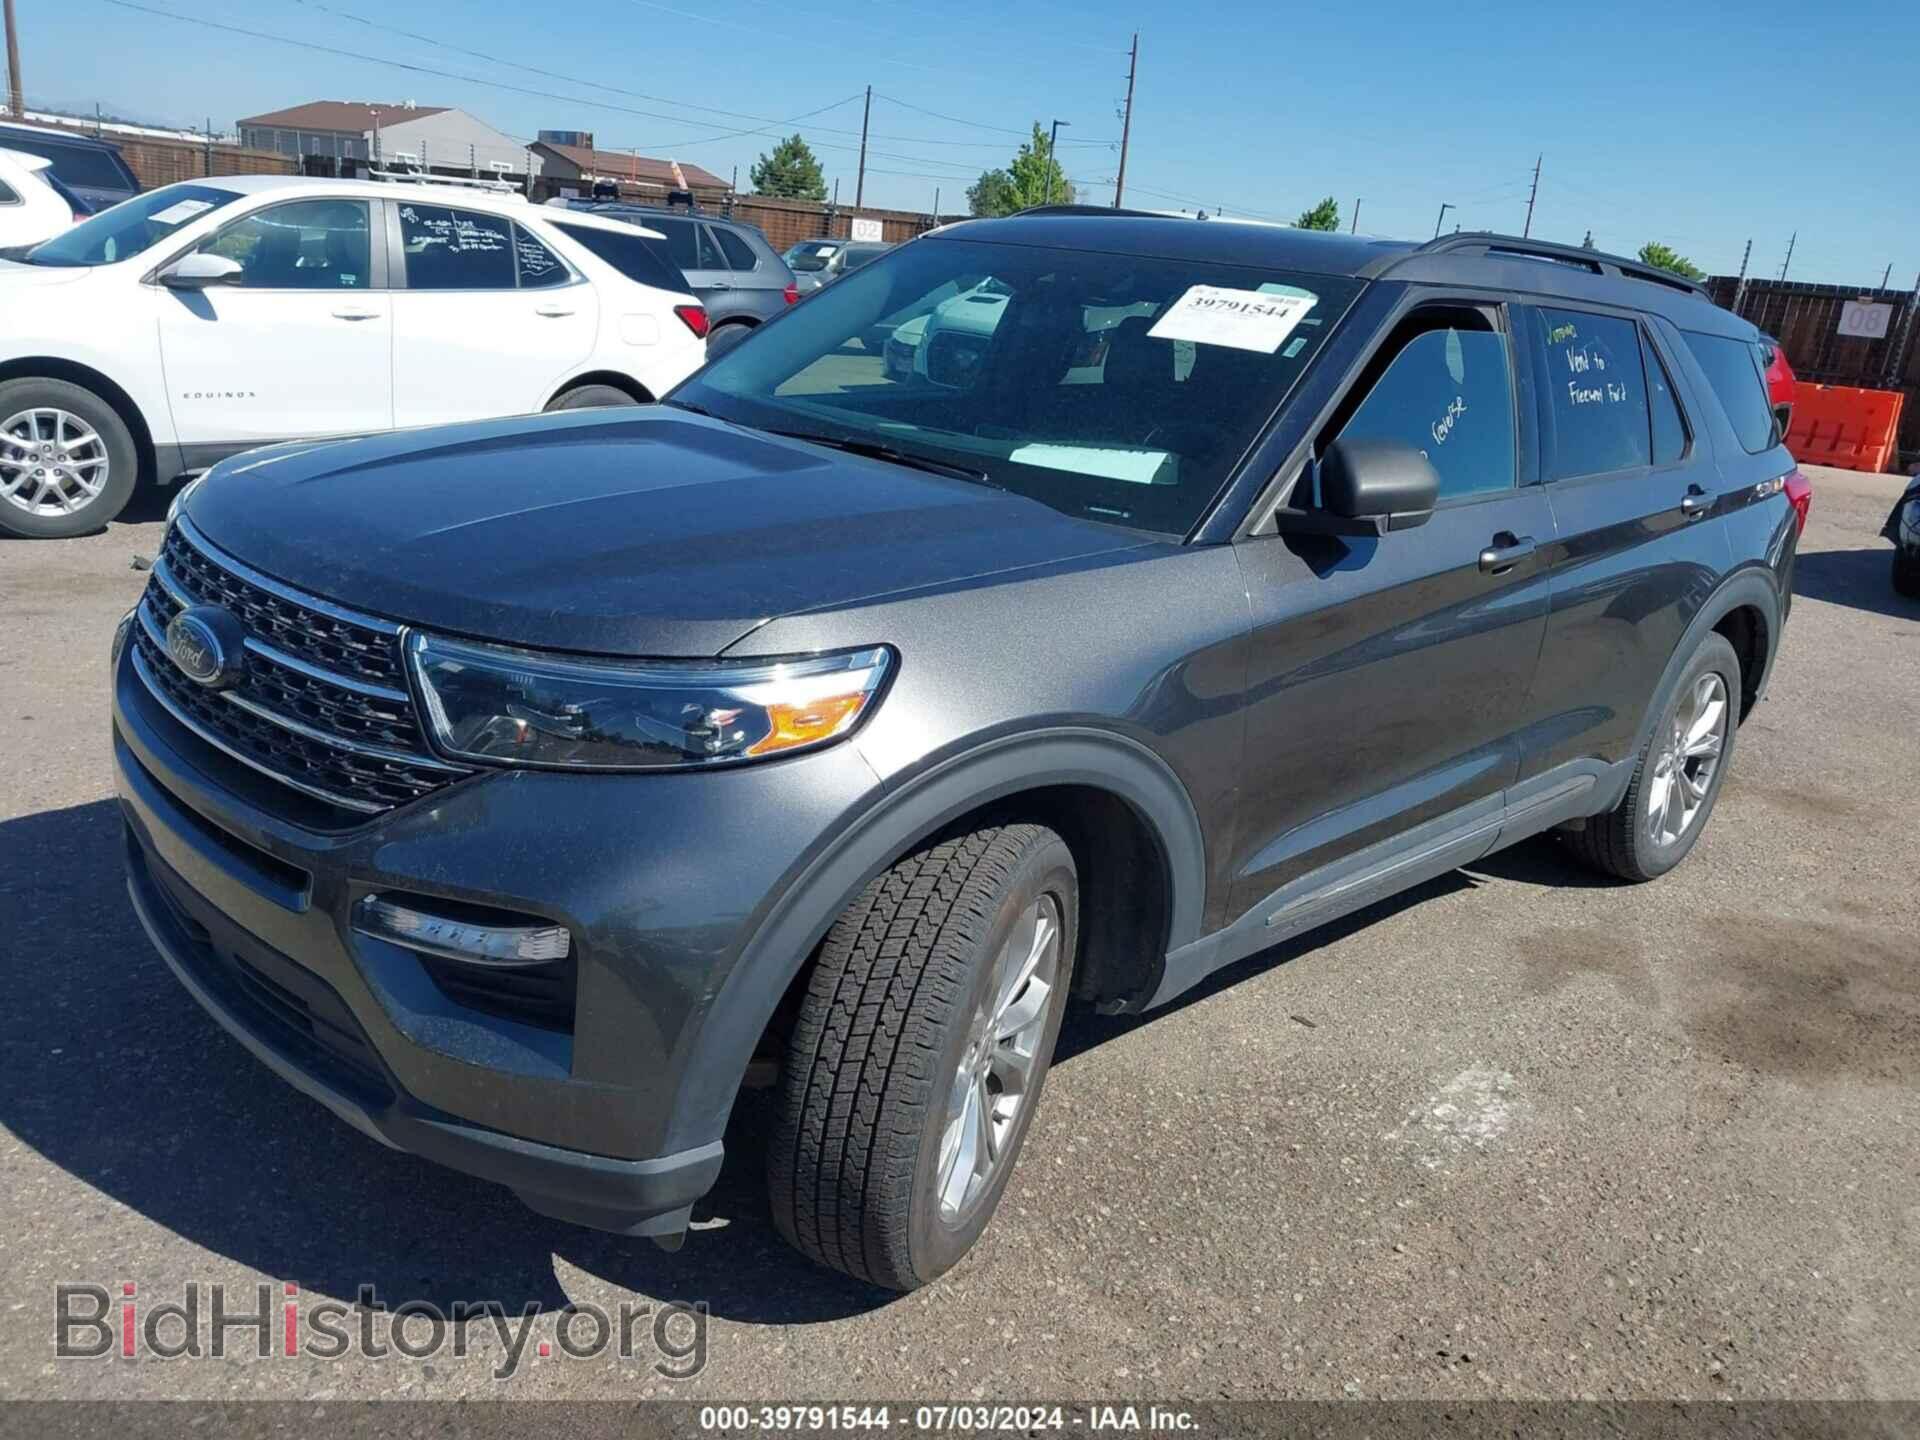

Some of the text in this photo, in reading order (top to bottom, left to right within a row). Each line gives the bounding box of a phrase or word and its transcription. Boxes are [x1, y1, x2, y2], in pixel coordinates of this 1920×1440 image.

[857, 221, 879, 238] 02
[1188, 297, 1290, 318] 39791544
[1593, 351, 1605, 371] to
[183, 391, 256, 399] EQUINOX
[172, 627, 206, 668] Ford
